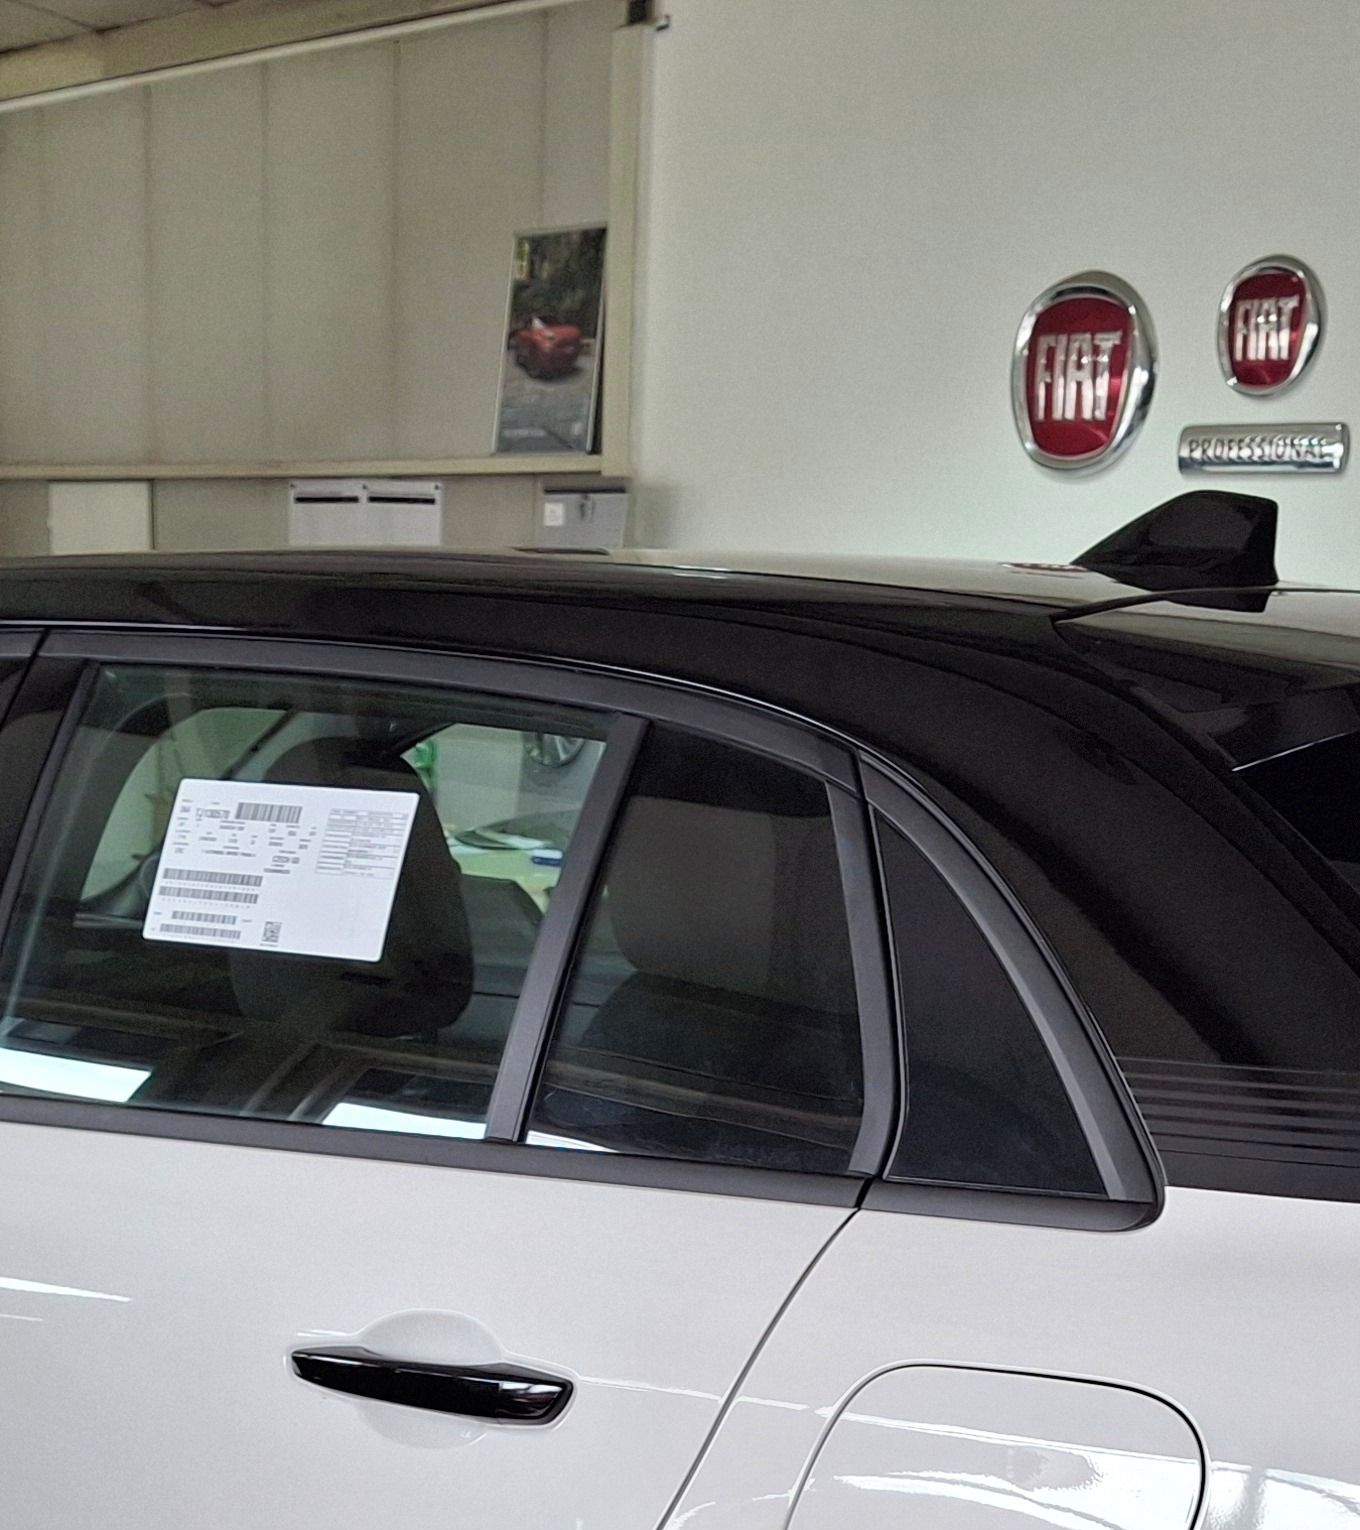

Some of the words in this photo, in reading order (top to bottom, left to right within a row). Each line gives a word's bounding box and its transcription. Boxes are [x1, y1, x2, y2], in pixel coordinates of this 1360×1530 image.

[1235, 296, 1299, 361] FIAT
[1036, 332, 1122, 421] FIAT
[1187, 437, 1333, 463] PROFESSIONAL
